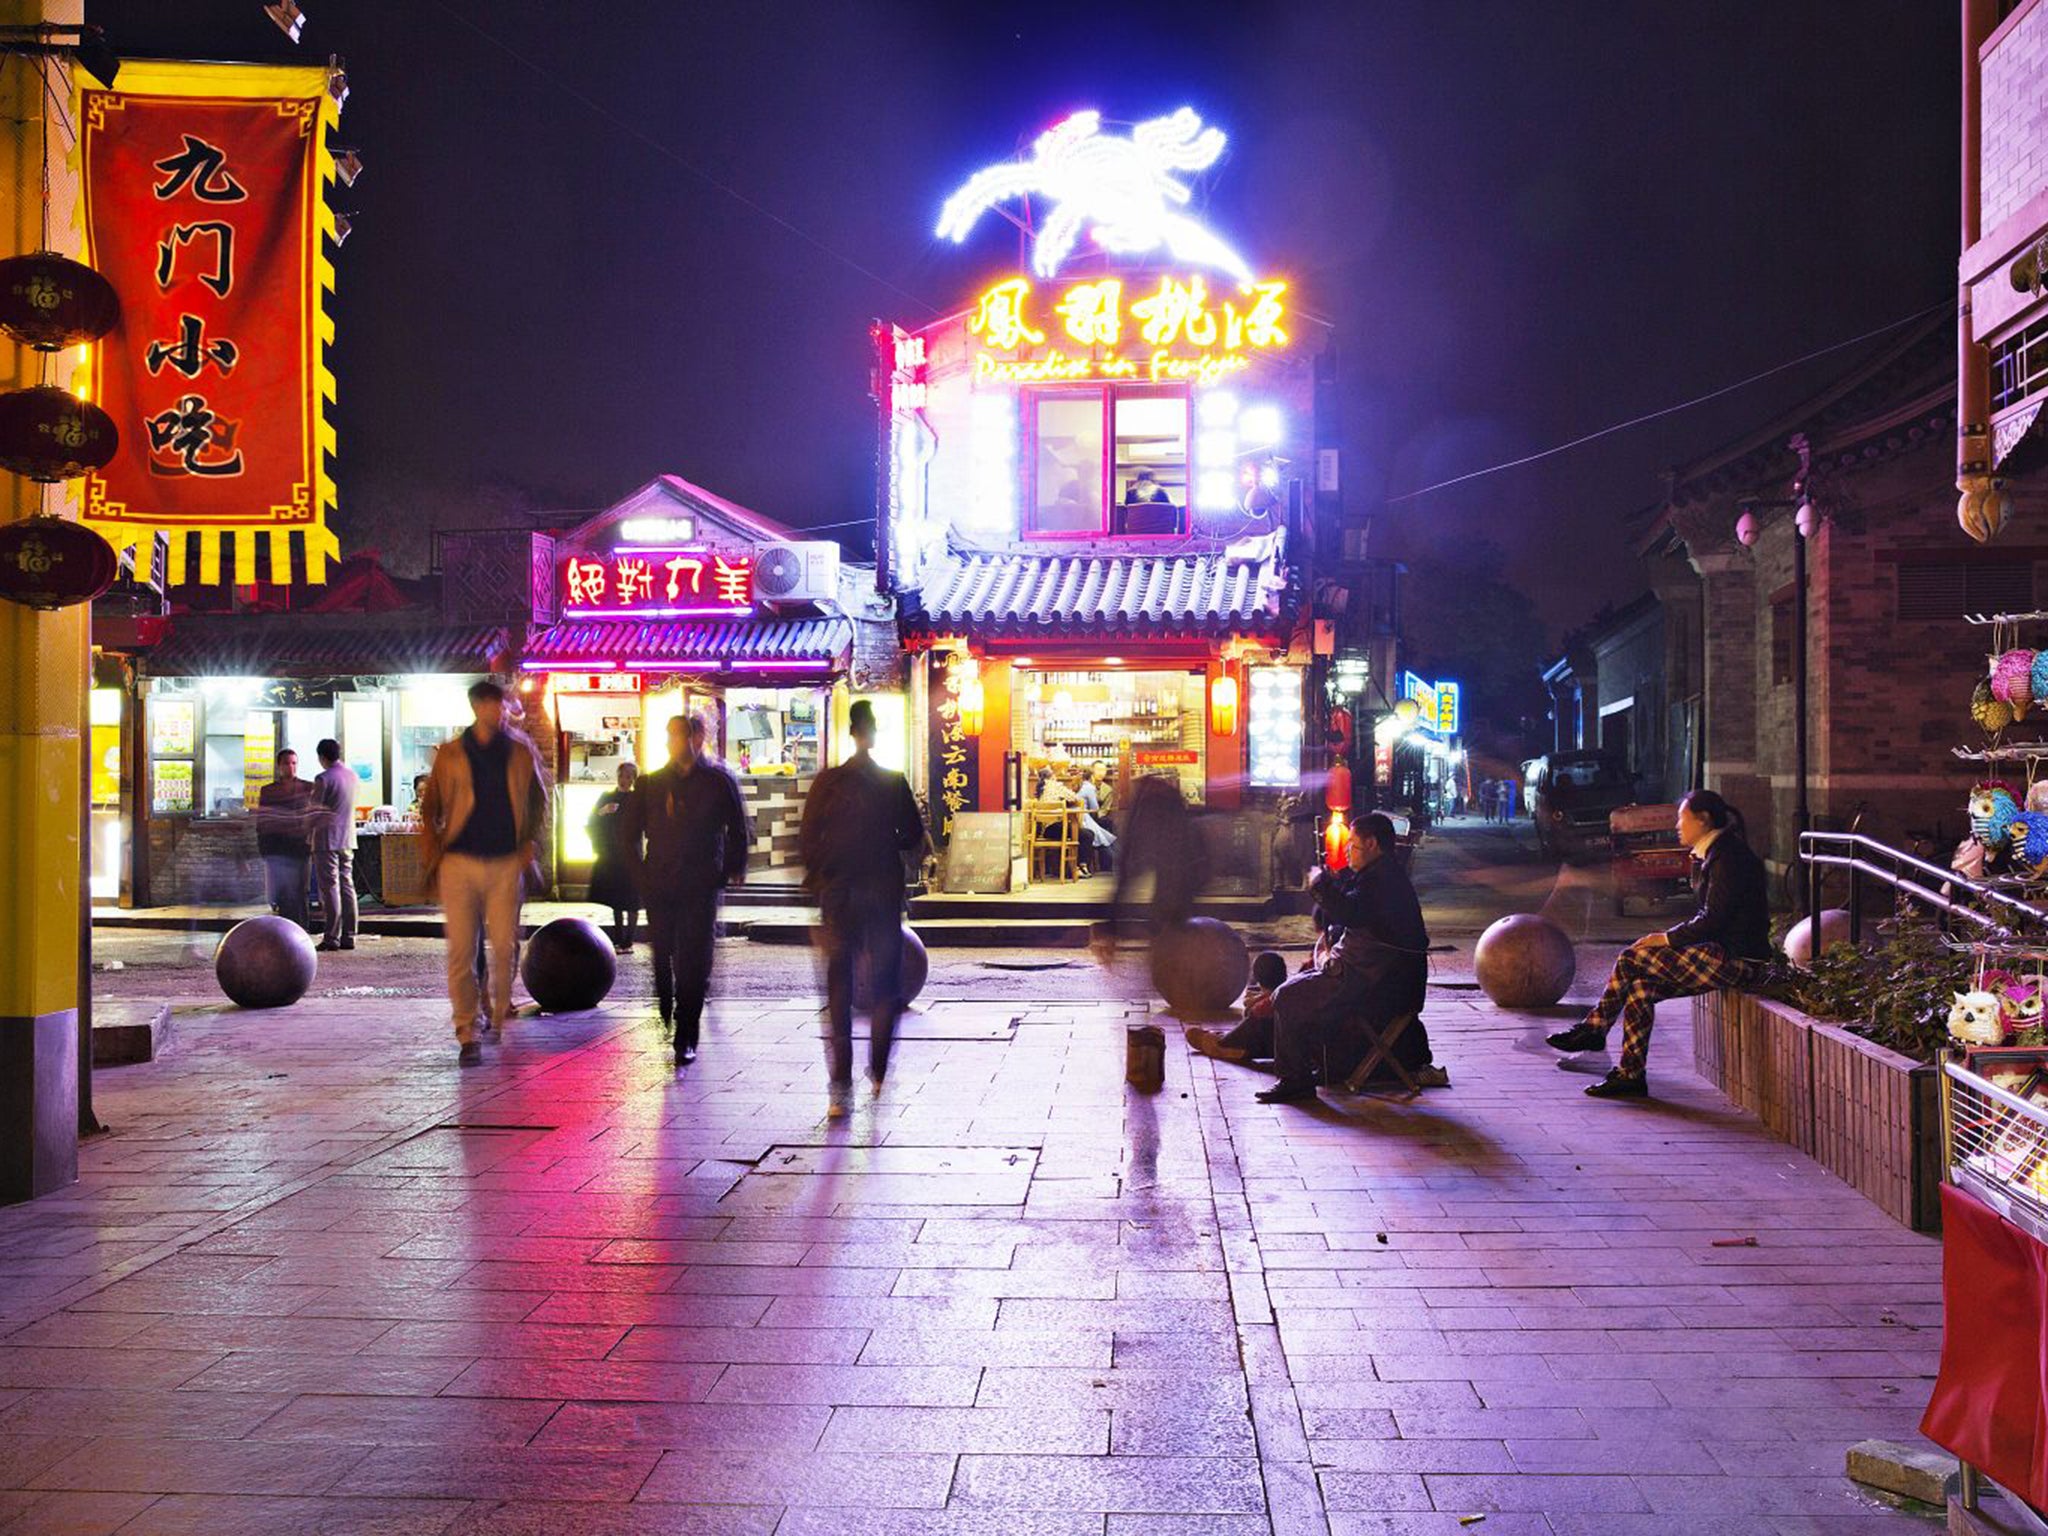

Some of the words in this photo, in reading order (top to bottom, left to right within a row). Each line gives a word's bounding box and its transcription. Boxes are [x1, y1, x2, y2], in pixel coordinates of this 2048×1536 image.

[146, 134, 249, 478] 九门小吃
[1100, 351, 1137, 377] in
